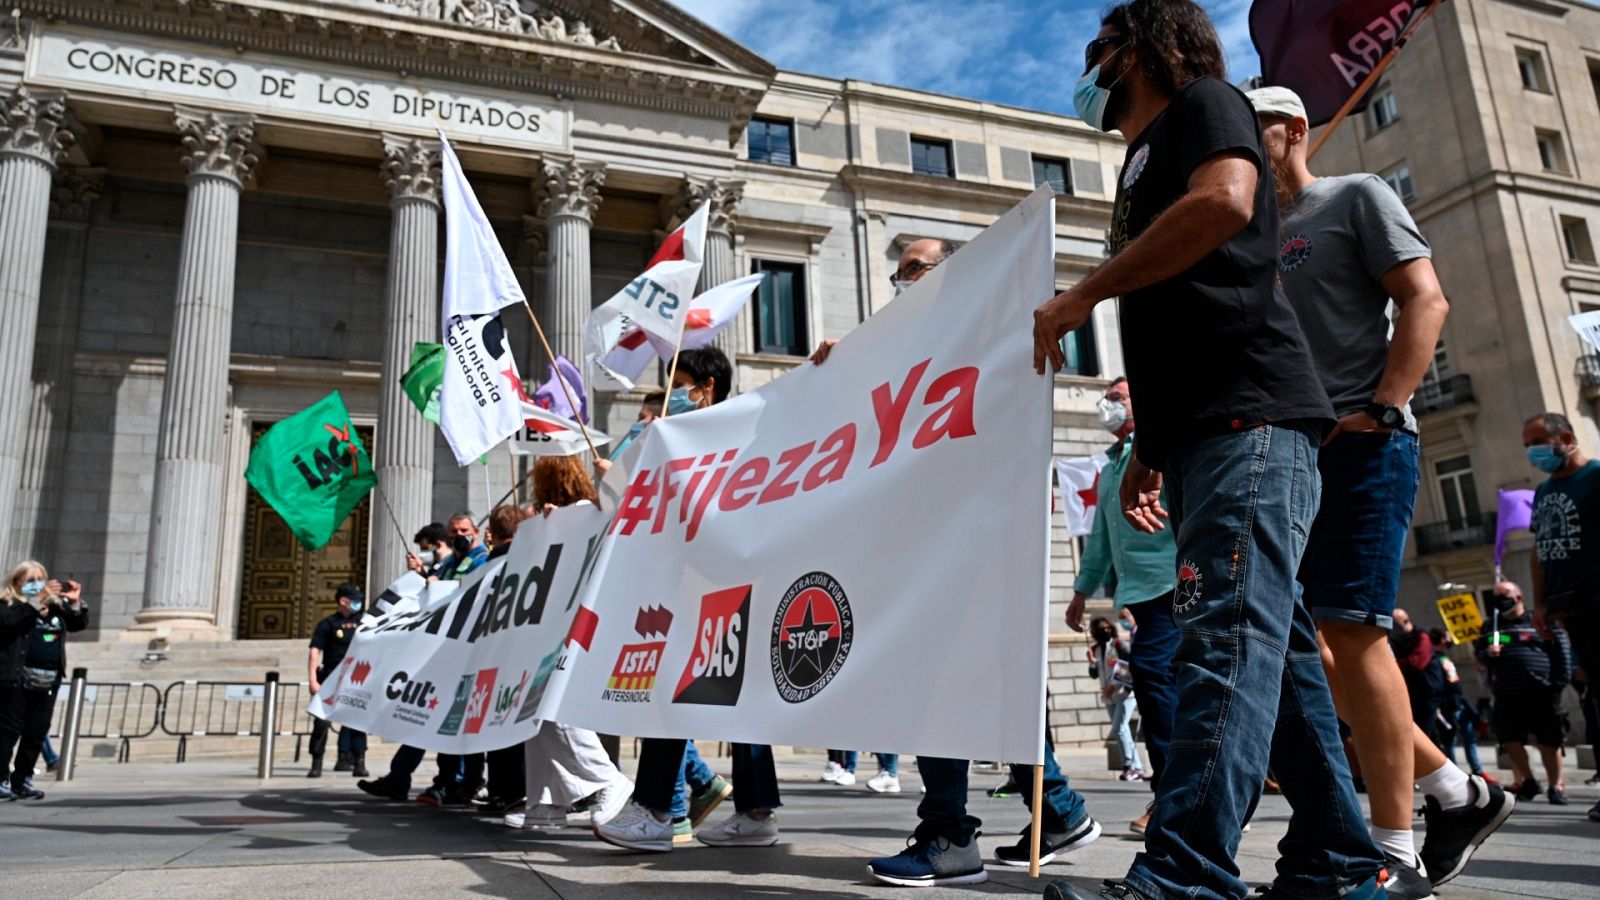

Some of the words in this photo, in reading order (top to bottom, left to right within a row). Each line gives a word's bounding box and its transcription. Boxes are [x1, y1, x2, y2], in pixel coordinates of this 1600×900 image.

[67, 47, 237, 91] CONGRESO
[260, 75, 297, 100] DE
[318, 83, 370, 110] LOS
[392, 94, 542, 133] DIPUTADOS
[464, 337, 502, 404] Unitaria
[772, 572, 829, 635] ADMINISTRACIÓN
[827, 580, 851, 629] PÚBLICA
[619, 649, 658, 674] ISTA
[692, 612, 742, 678] SAS
[771, 646, 810, 702] SOLIDARIDAD
[811, 641, 851, 696] OBRERA
[601, 688, 651, 703] INTERSINDICAL
